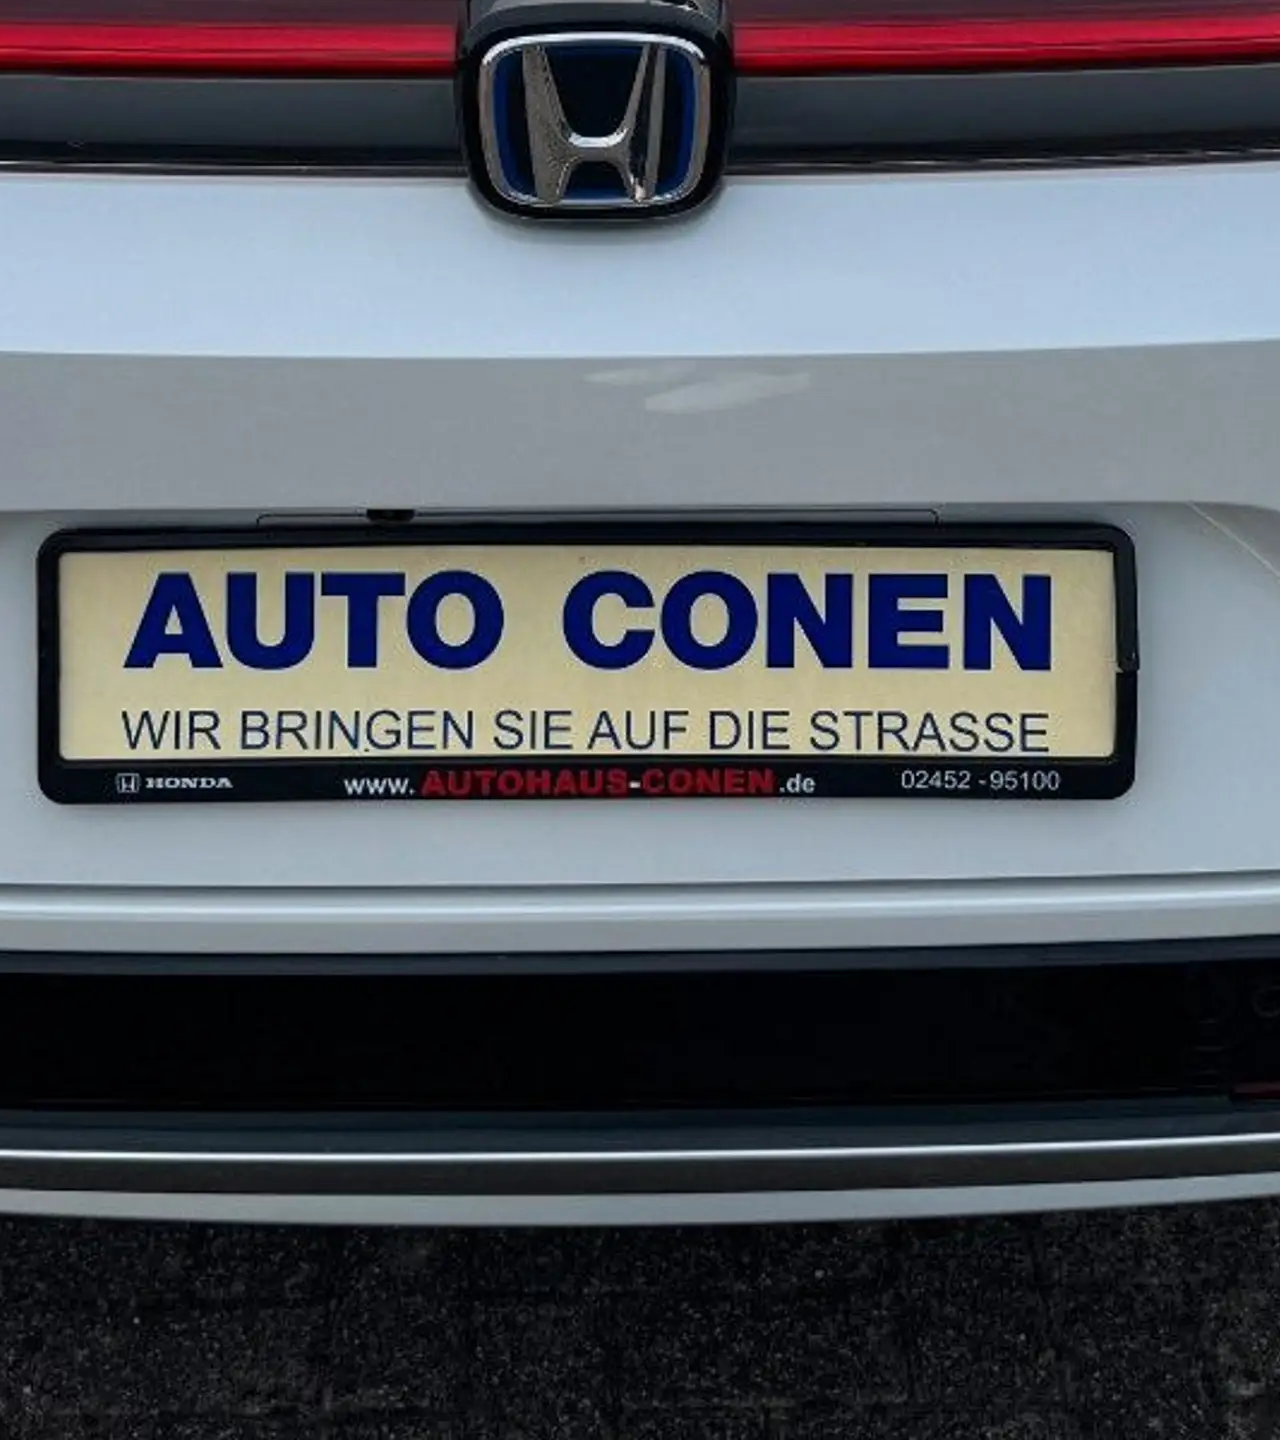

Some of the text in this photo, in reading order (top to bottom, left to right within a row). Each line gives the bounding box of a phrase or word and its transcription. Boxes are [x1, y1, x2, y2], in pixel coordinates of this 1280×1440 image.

[122, 570, 1052, 672] AUTO CONEN
[121, 709, 1050, 753] WIR BRINGEN SIE AUF DIE STRASSE
[145, 776, 233, 789] HONDA
[900, 770, 971, 790] 02452
